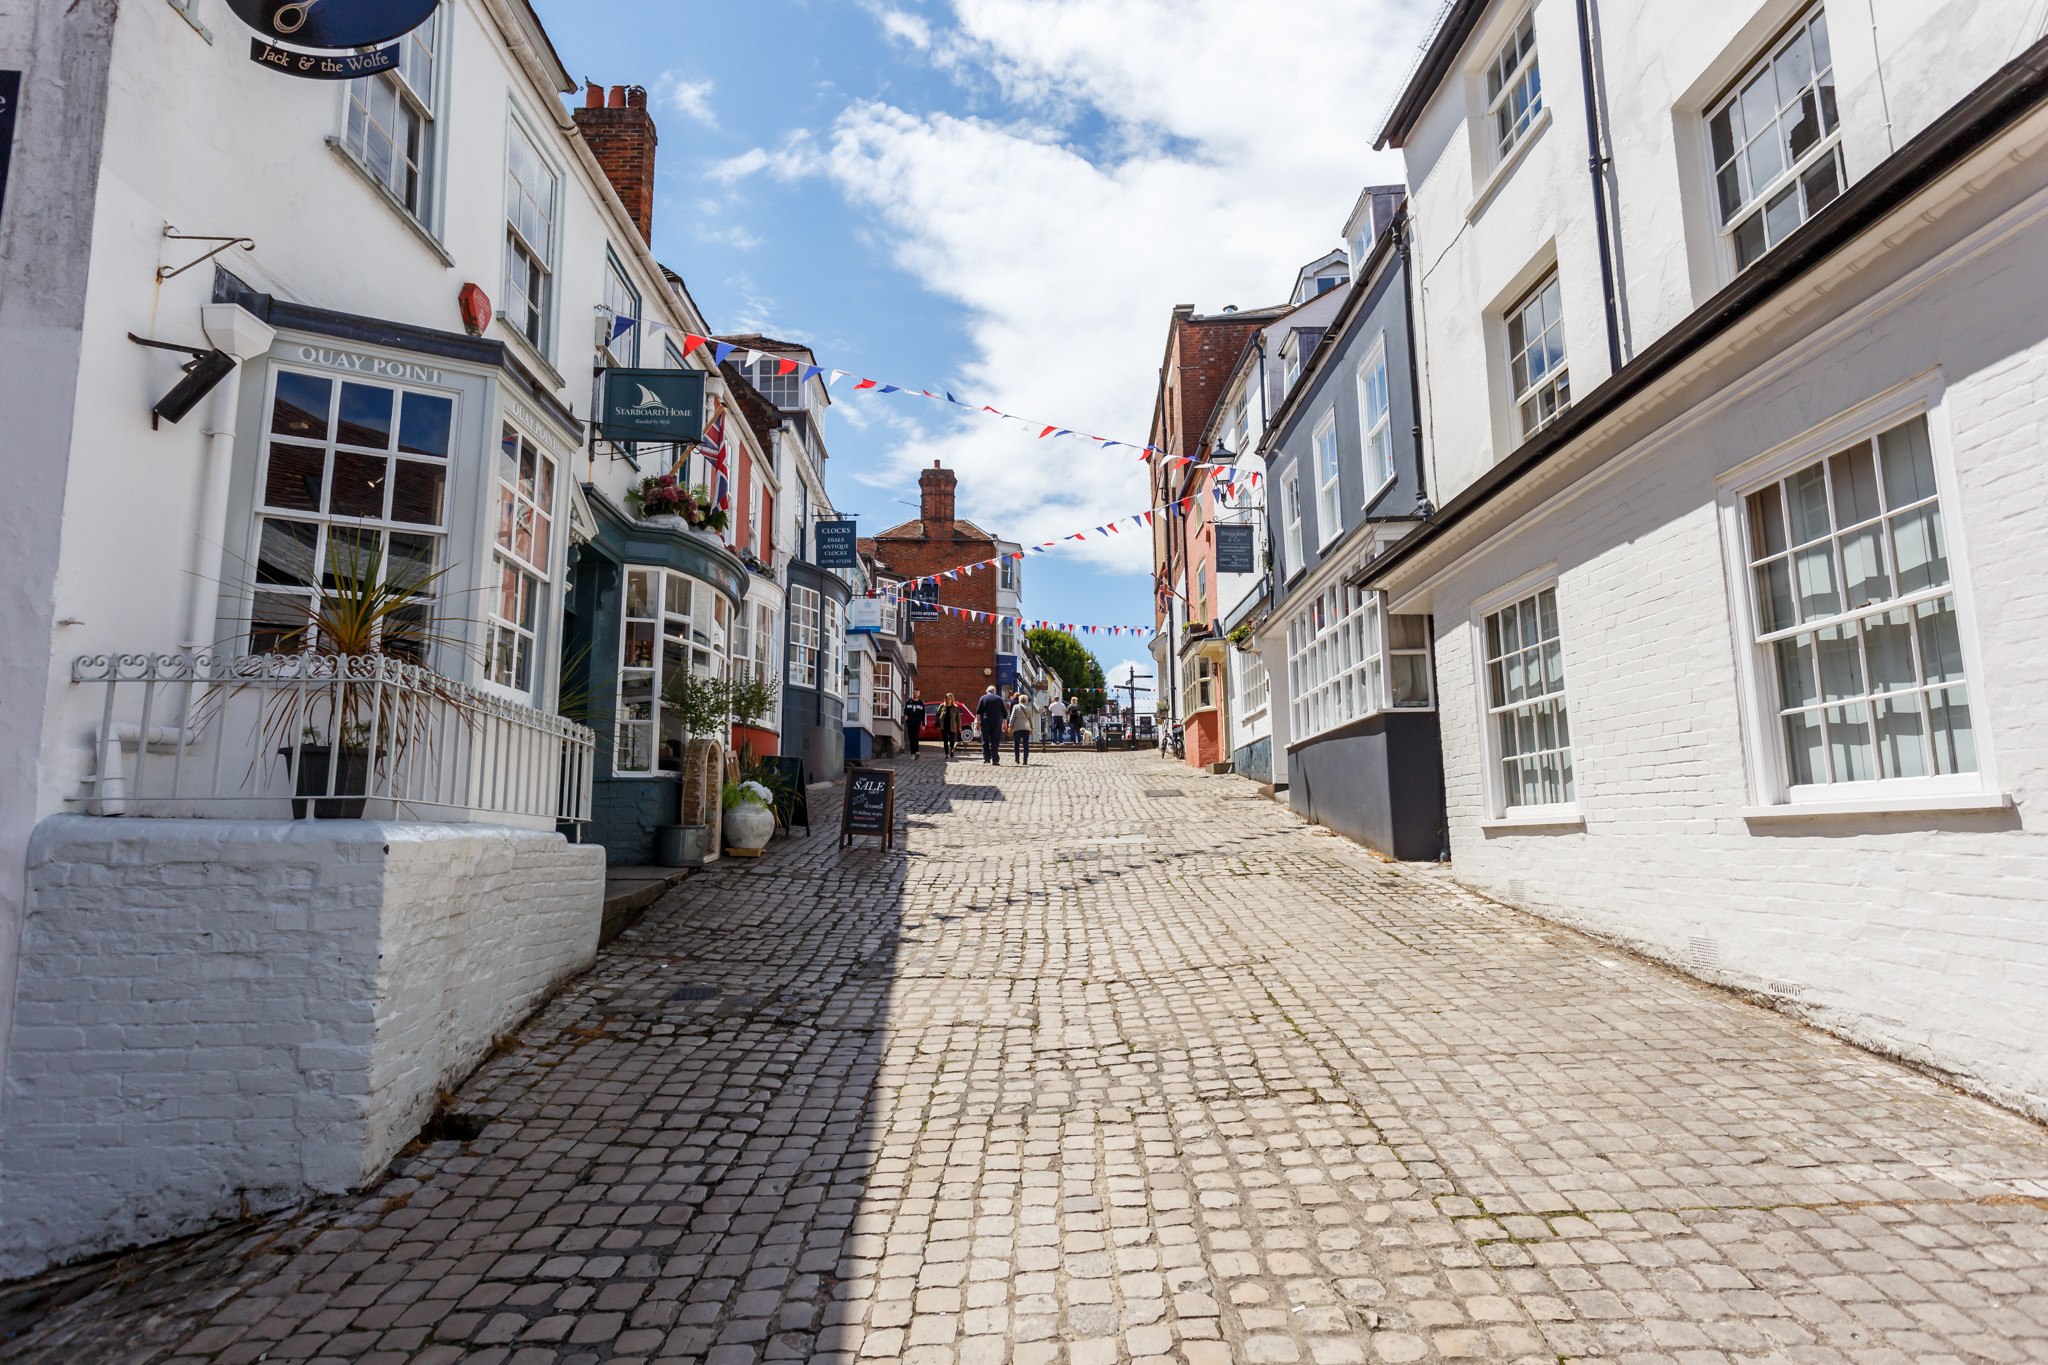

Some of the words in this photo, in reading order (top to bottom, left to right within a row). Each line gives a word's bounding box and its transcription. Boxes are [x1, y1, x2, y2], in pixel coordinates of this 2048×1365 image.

[259, 46, 290, 67] Jack
[299, 57, 314, 70] &
[321, 58, 344, 72] the
[346, 52, 389, 71] Wolfe
[298, 347, 366, 371] QUAY
[373, 359, 443, 384] POINT
[615, 406, 664, 417] STARBOARD
[665, 407, 692, 417] HOME
[513, 401, 534, 428] QUAY
[536, 421, 556, 450] POINT
[854, 781, 885, 791] SALE
